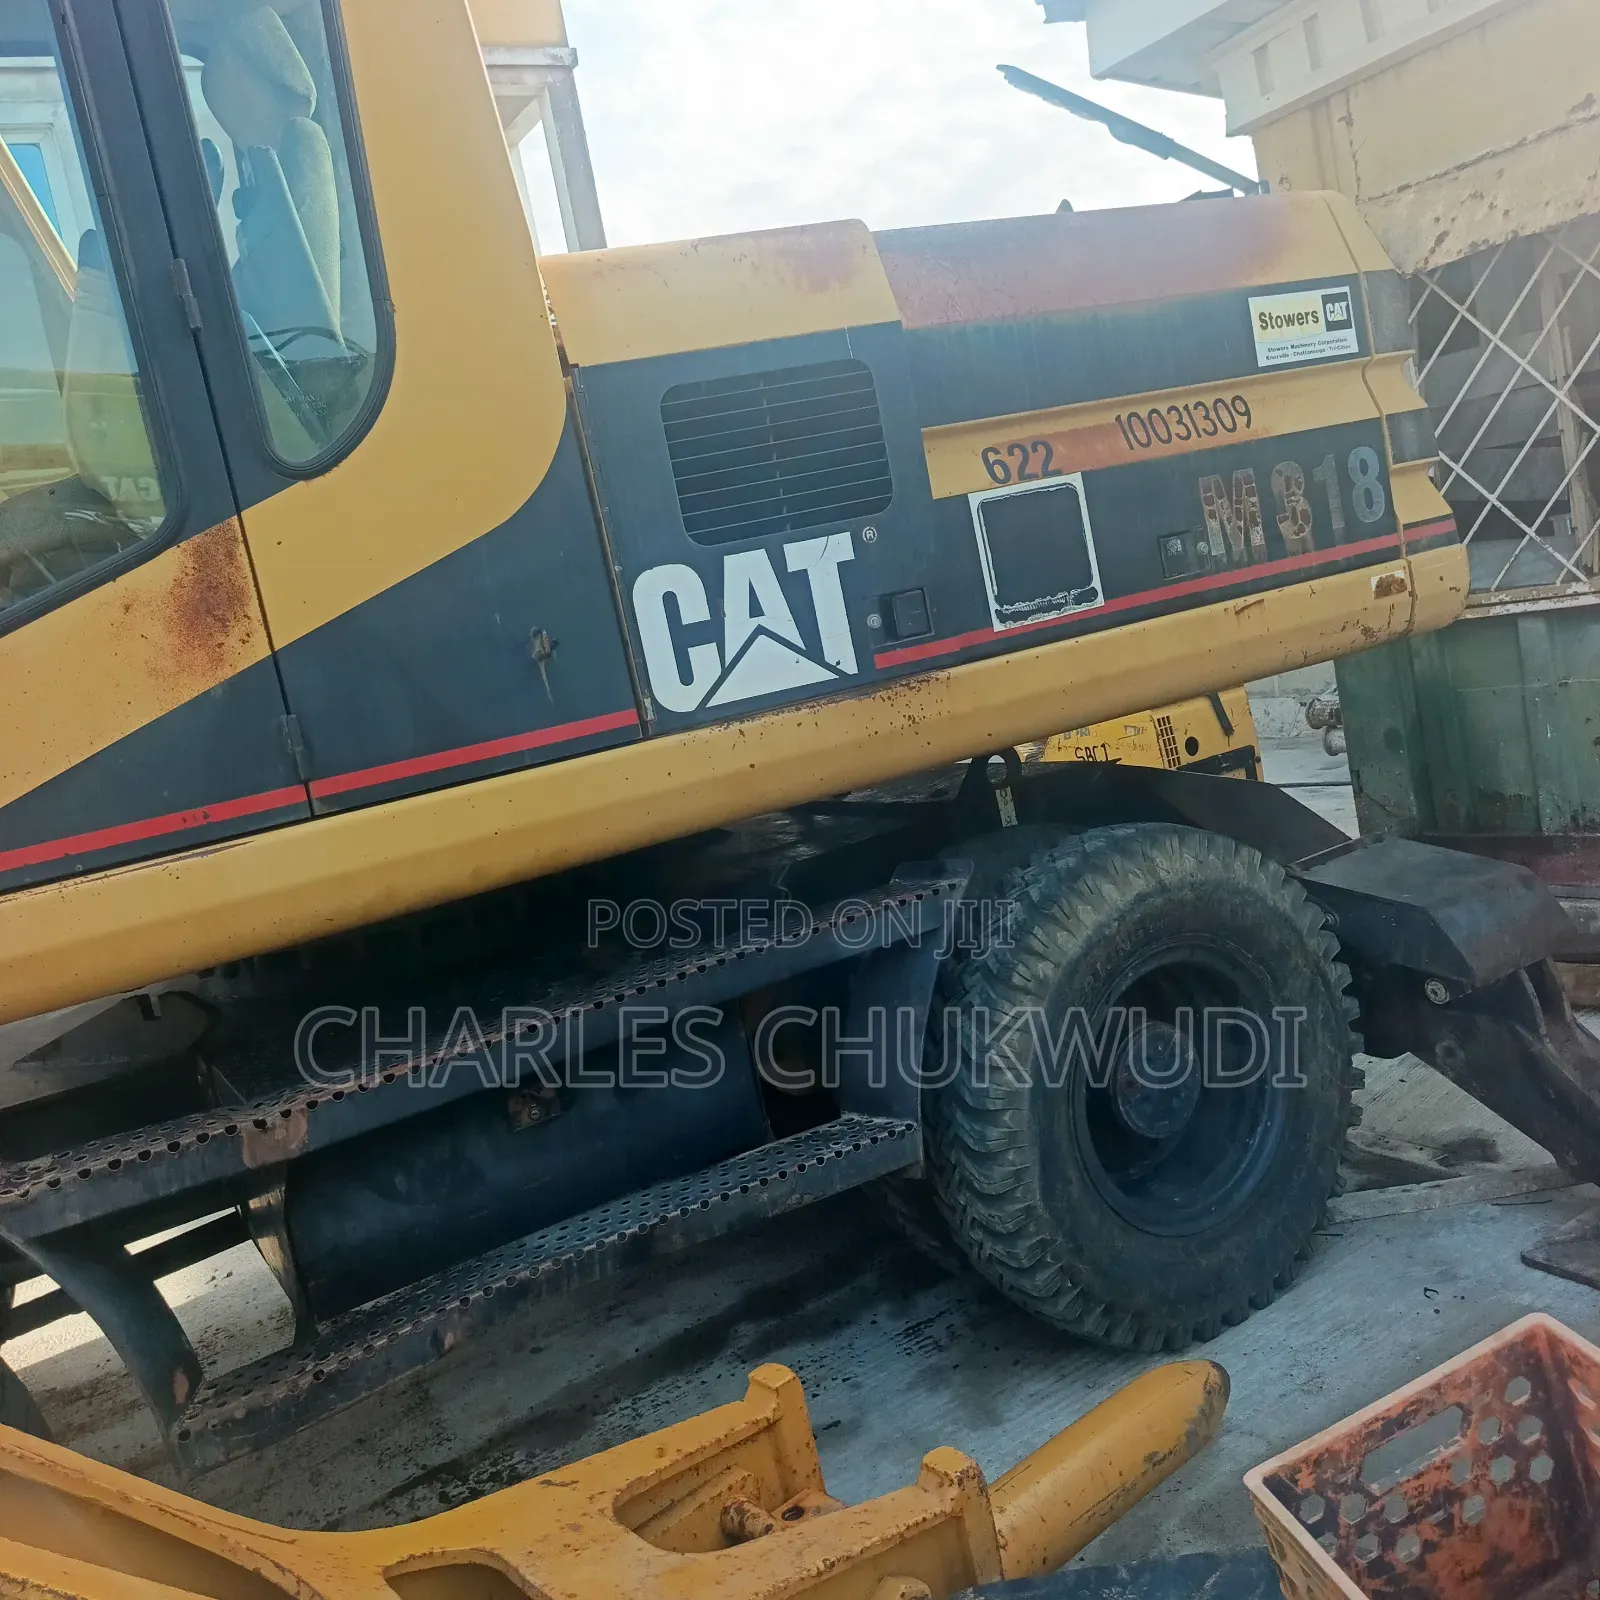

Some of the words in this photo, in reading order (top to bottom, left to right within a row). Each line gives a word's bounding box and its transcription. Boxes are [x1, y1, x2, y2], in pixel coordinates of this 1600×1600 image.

[1258, 310, 1320, 331] Stowers
[1325, 301, 1348, 322] CAT
[1317, 337, 1348, 346] Corporation
[1114, 394, 1252, 450] 10031309
[980, 439, 1062, 485] 622
[632, 531, 859, 713] CAT
